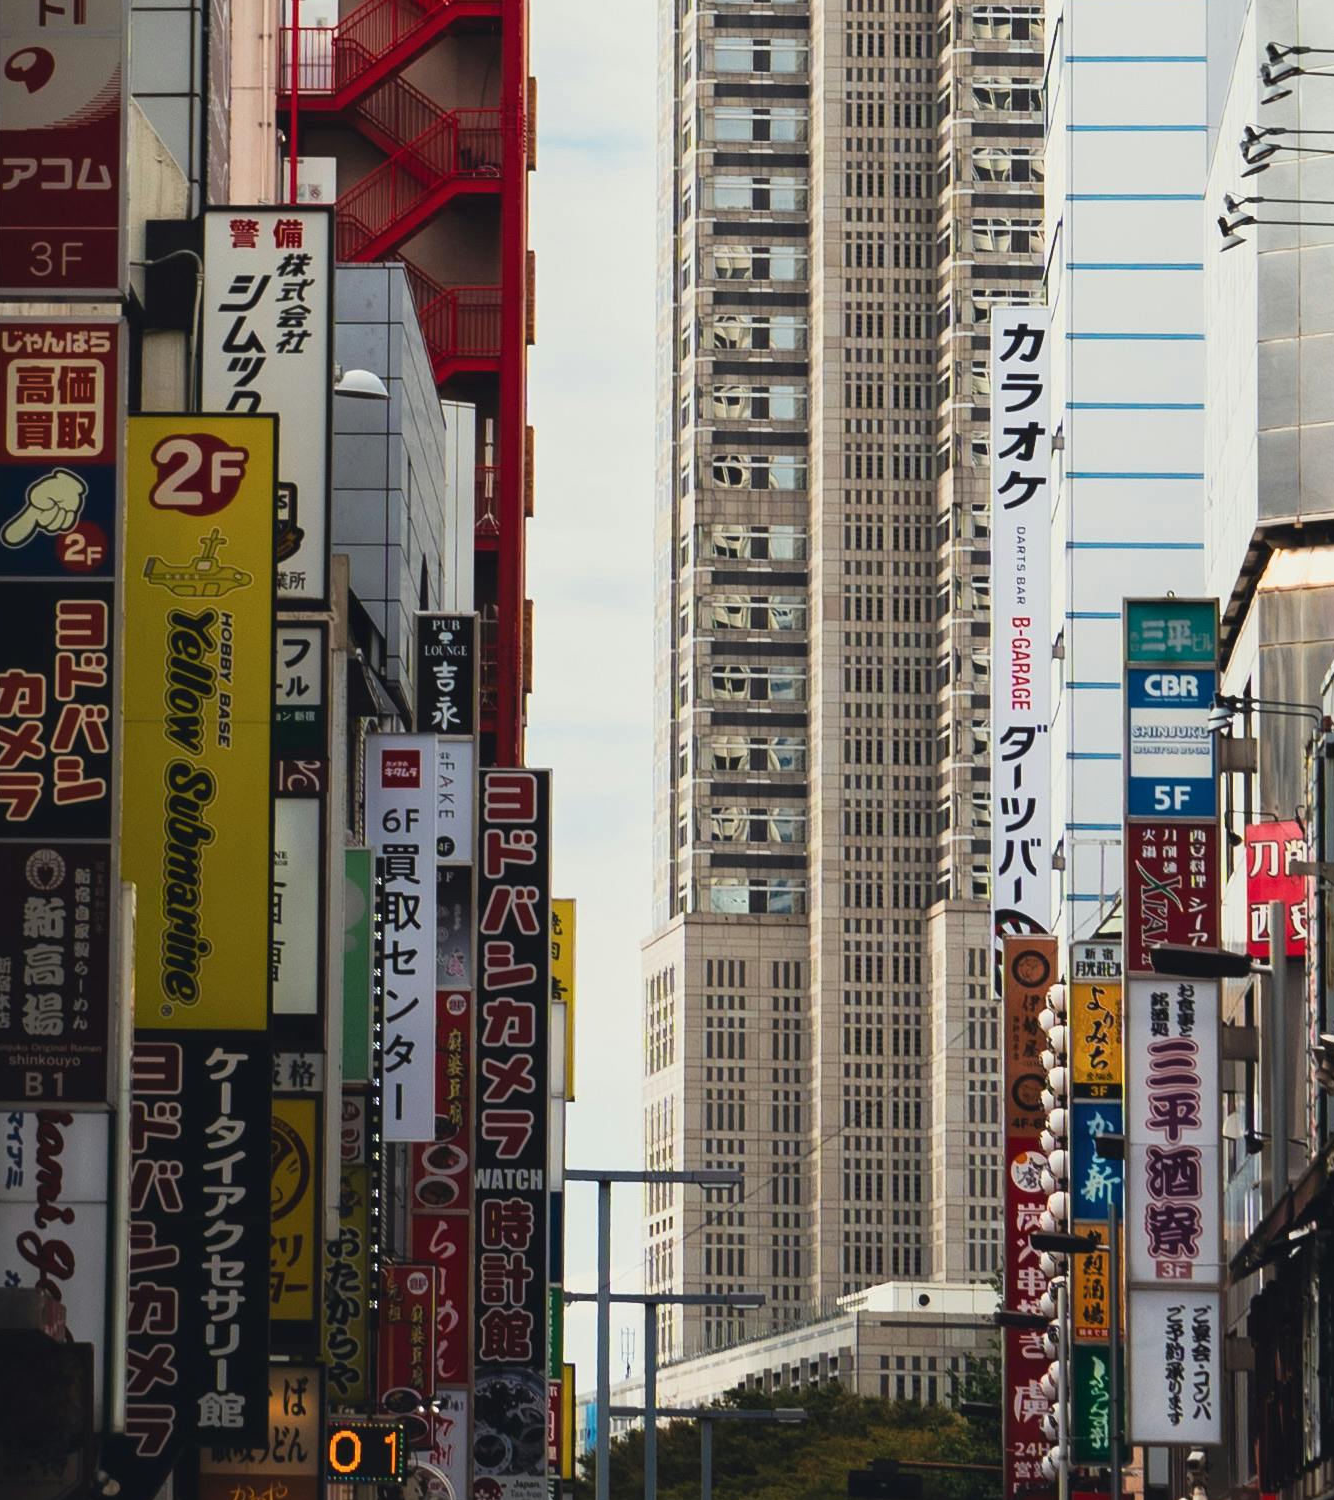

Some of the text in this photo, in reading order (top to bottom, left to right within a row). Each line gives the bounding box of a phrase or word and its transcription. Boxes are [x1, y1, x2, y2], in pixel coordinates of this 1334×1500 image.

[1, 157, 112, 192] アコム
[28, 240, 85, 277] 3F
[229, 219, 304, 249] 警備
[275, 253, 315, 354] 株式会社
[1, 330, 112, 354] じゃんぱら
[15, 365, 98, 405] 高価
[15, 409, 98, 451] 買取
[997, 323, 1047, 510] カラオケ
[151, 438, 246, 506] 2F
[64, 533, 104, 567] 2F
[1015, 526, 1027, 605] DARTS BAR
[432, 619, 461, 631] PUB
[424, 645, 468, 656] LOUNGE
[1011, 616, 1032, 711] B-GARAGE
[50, 599, 109, 806] ヨドバシ
[217, 611, 234, 749] HOBBY BASE
[431, 660, 462, 732] 吉永
[1144, 674, 1199, 698] CBR
[1132, 726, 1210, 738] SHINJUKU
[165, 607, 218, 1005] Yellow Submarine
[438, 760, 455, 819] FAKE
[999, 723, 1050, 905] ダーツバー
[1154, 785, 1192, 812] 5F
[382, 808, 420, 834] 6F
[479, 772, 540, 1160] ヨドバシカメラ
[1084, 948, 1115, 960] 新宿
[381, 843, 422, 1122] 買取センター
[1084, 985, 1115, 1071] よりみち
[9, 1054, 82, 1068] shinkouyo
[1089, 1085, 1109, 1098] 3F
[473, 1167, 545, 1192] WATCH
[125, 1041, 184, 1457] ヨドバシカメラ
[197, 1047, 249, 1428] ケータイアクセサリー館
[478, 1196, 535, 1363] 時計館
[1160, 1263, 1188, 1278] 3F
[325, 1227, 364, 1397] おたからや
